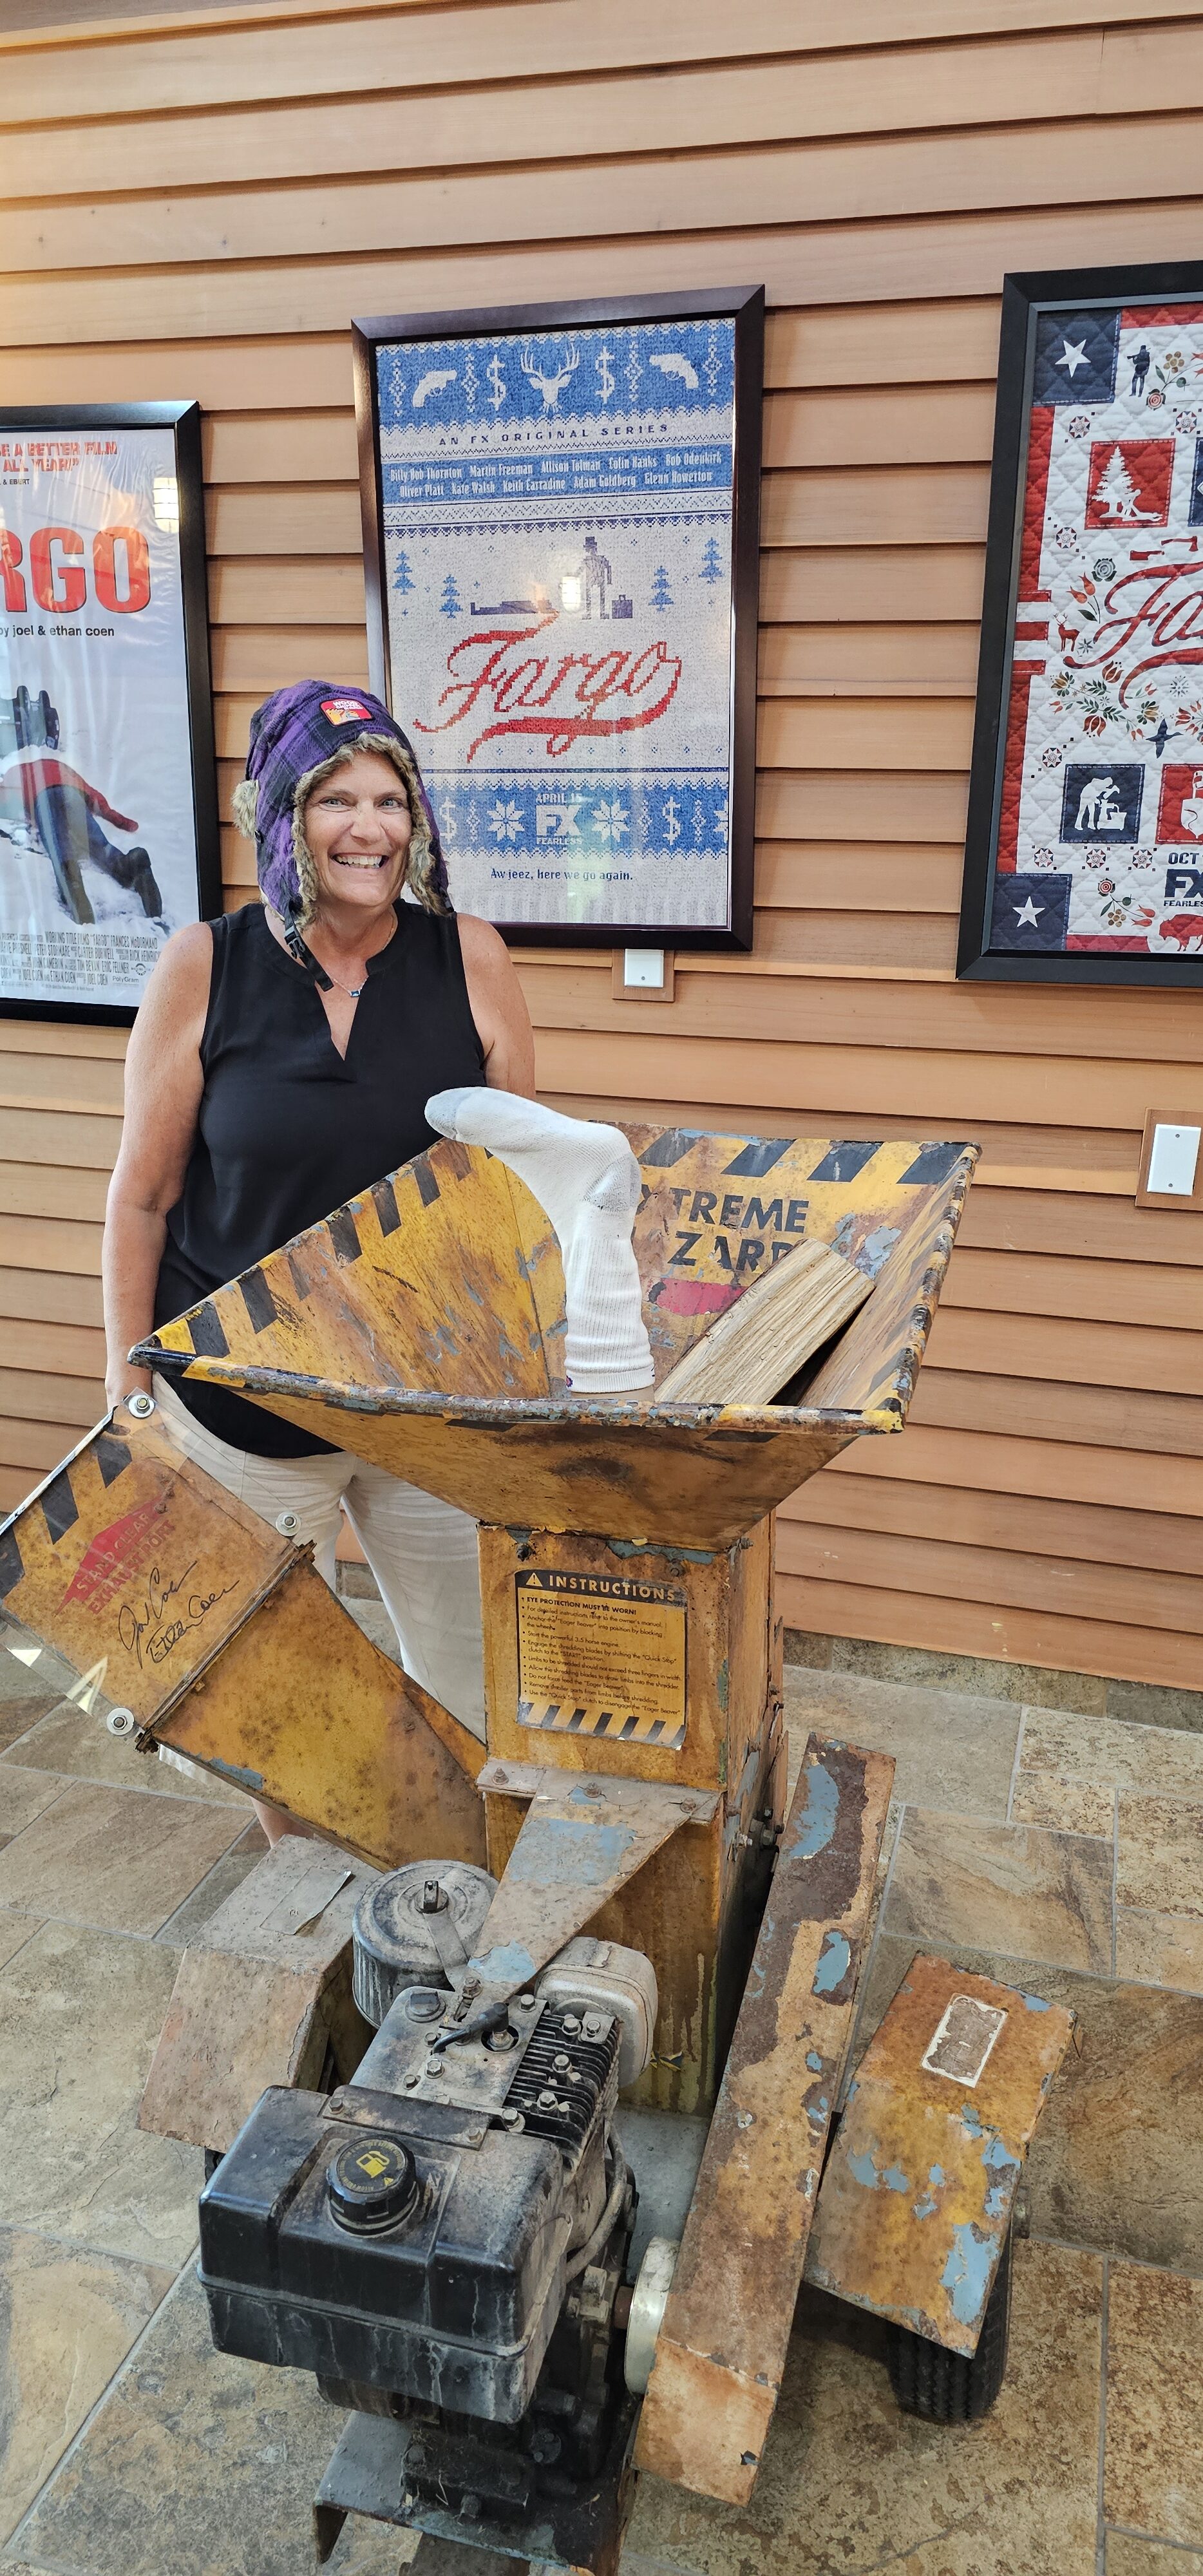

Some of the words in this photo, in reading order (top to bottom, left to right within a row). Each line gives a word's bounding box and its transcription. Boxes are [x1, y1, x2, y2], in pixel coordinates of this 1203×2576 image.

[439, 437, 459, 446] AN
[471, 435, 489, 444] FX
[502, 430, 589, 442] ORIGINAL
[601, 424, 668, 436] SERIES
[28, 442, 81, 456] BETTER
[84, 441, 117, 455] FILM
[3, 459, 29, 473] ALL
[390, 469, 408, 482] Billy
[410, 468, 424, 480] Bob
[427, 467, 462, 480] Thornton
[469, 464, 497, 477] Martin
[499, 462, 533, 477] Freeman
[541, 460, 569, 473] Allison
[571, 459, 601, 472] Tolman
[608, 456, 630, 470] Colin
[632, 455, 658, 468] Hanks
[665, 453, 681, 466] Bob
[683, 451, 722, 466] Odenkirk
[400, 485, 422, 498] Oliver
[424, 484, 444, 496] Platt
[451, 482, 470, 495] Kate
[472, 481, 495, 494] Walsh
[503, 480, 524, 493] Keith
[526, 478, 565, 492] Carradine
[574, 475, 596, 489] Adam
[599, 473, 637, 488] Goldberg
[644, 471, 669, 485] Glenn
[672, 470, 712, 483] Howerton
[13, 625, 34, 638] joel
[37, 625, 46, 636] &
[50, 625, 82, 636] ethan
[85, 627, 115, 636] coen
[413, 626, 681, 762] Fargo
[535, 793, 566, 804] APRIL
[536, 804, 582, 837] FX
[1168, 852, 1200, 864] OCT
[491, 868, 506, 878] Aw
[507, 869, 533, 881] jeez,
[538, 869, 561, 879] here
[564, 871, 580, 880] we
[583, 871, 596, 881] go
[600, 871, 633, 882] again.
[77, 1551, 115, 1593] STAND
[114, 1513, 150, 1550] CLEAR
[87, 1553, 145, 1615] EXHAUST
[141, 1520, 176, 1557] PORT
[549, 1575, 676, 1602] INSTRUCTIONS
[540, 1598, 581, 1609] PROTECTION
[612, 1607, 637, 1615] WORN!
[560, 1610, 588, 1619] instructions
[640, 1628, 663, 1638] blocking
[641, 1670, 659, 1679] fingers
